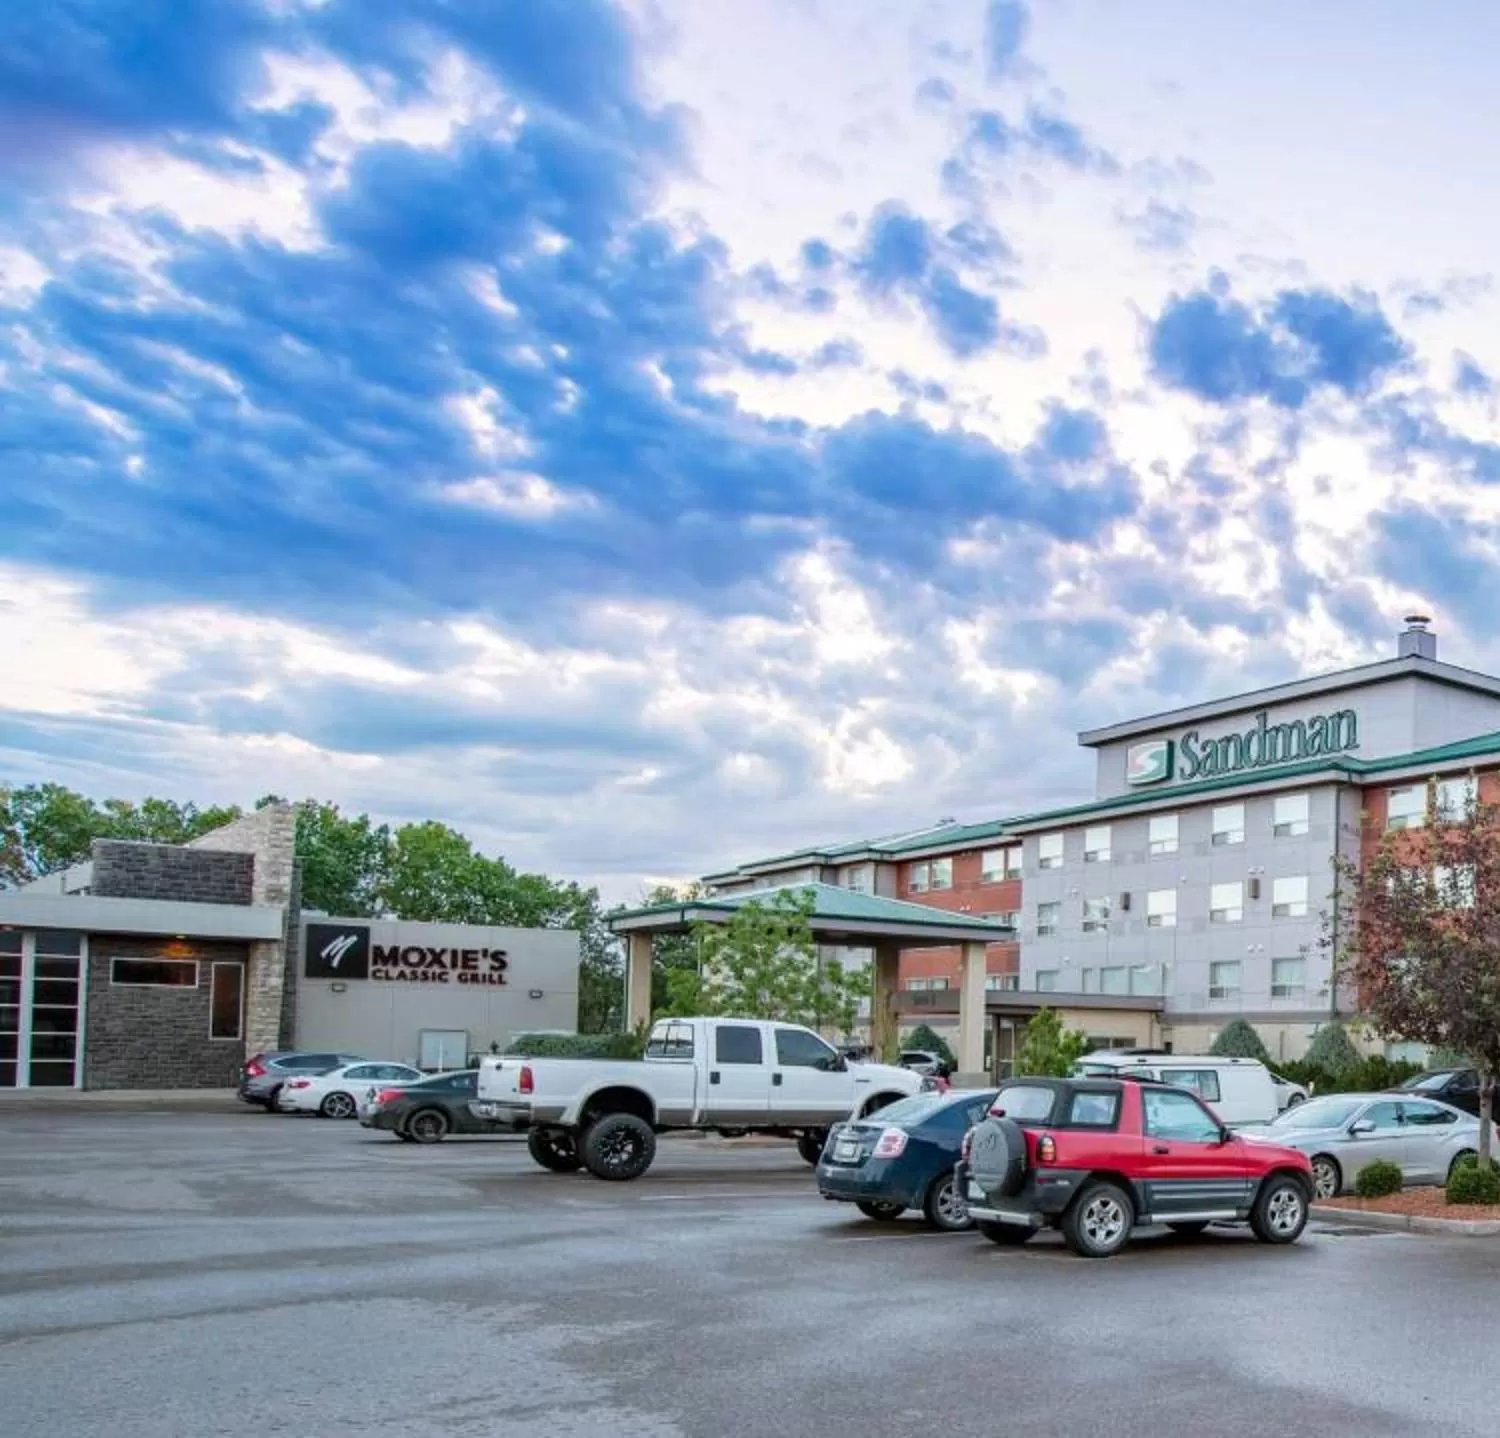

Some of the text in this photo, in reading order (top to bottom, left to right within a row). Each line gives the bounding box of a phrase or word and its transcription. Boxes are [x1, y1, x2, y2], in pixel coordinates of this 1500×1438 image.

[1179, 709, 1360, 779] Sandman
[371, 945, 508, 971] MOXIE'S
[371, 968, 508, 985] CLASSIC GRILL
